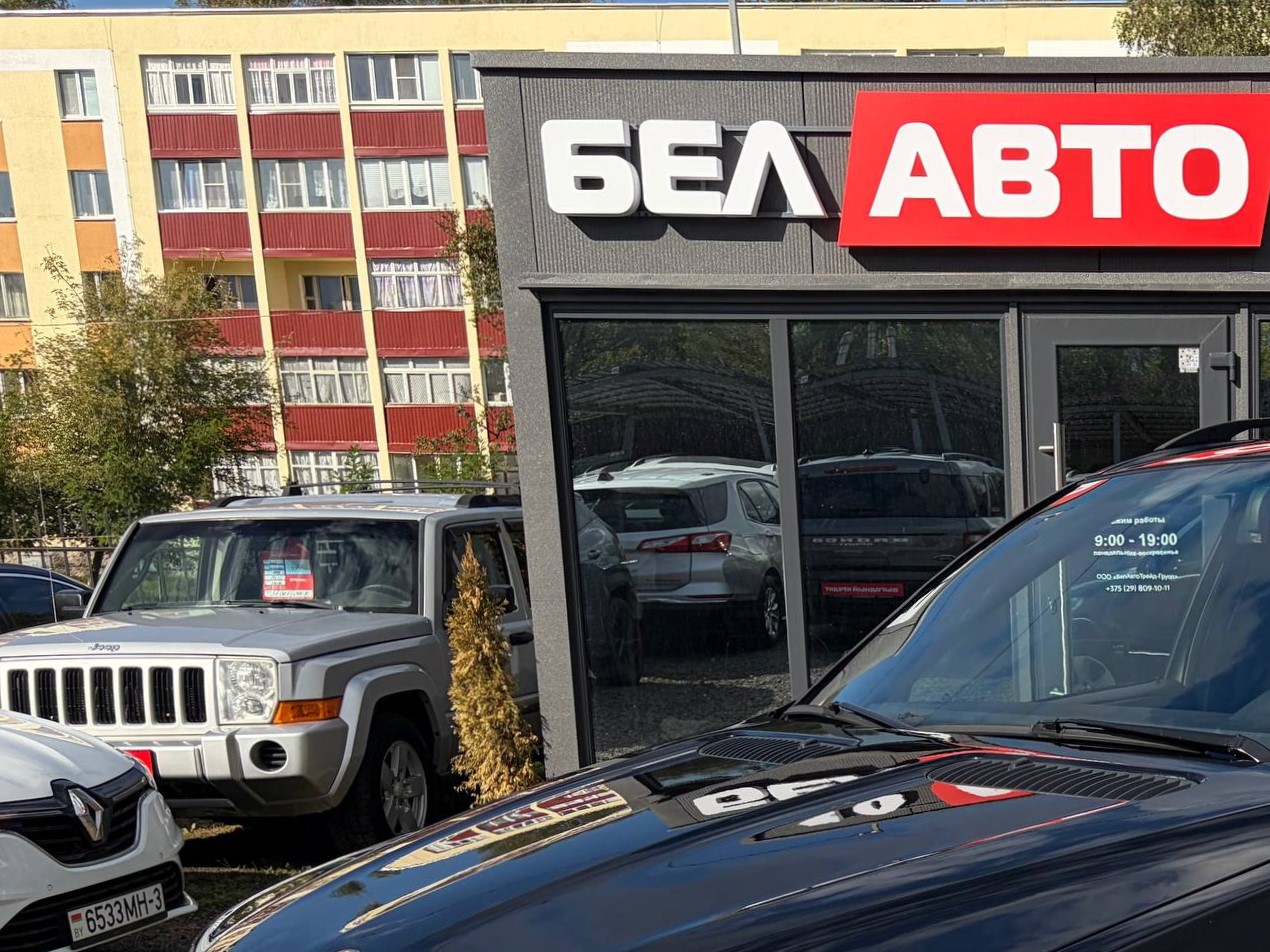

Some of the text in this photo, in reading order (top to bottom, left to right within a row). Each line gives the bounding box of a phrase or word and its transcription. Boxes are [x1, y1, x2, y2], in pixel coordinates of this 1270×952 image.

[540, 119, 827, 217] БЕЛ
[869, 122, 1250, 220] АВТО
[1134, 516, 1166, 525] работы
[1094, 534, 1125, 547] 9:00
[1138, 532, 1178, 546] 19:00
[1123, 584, 1137, 593] (29)
[1138, 584, 1171, 592] 809-10-11
[73, 926, 85, 939] BY
